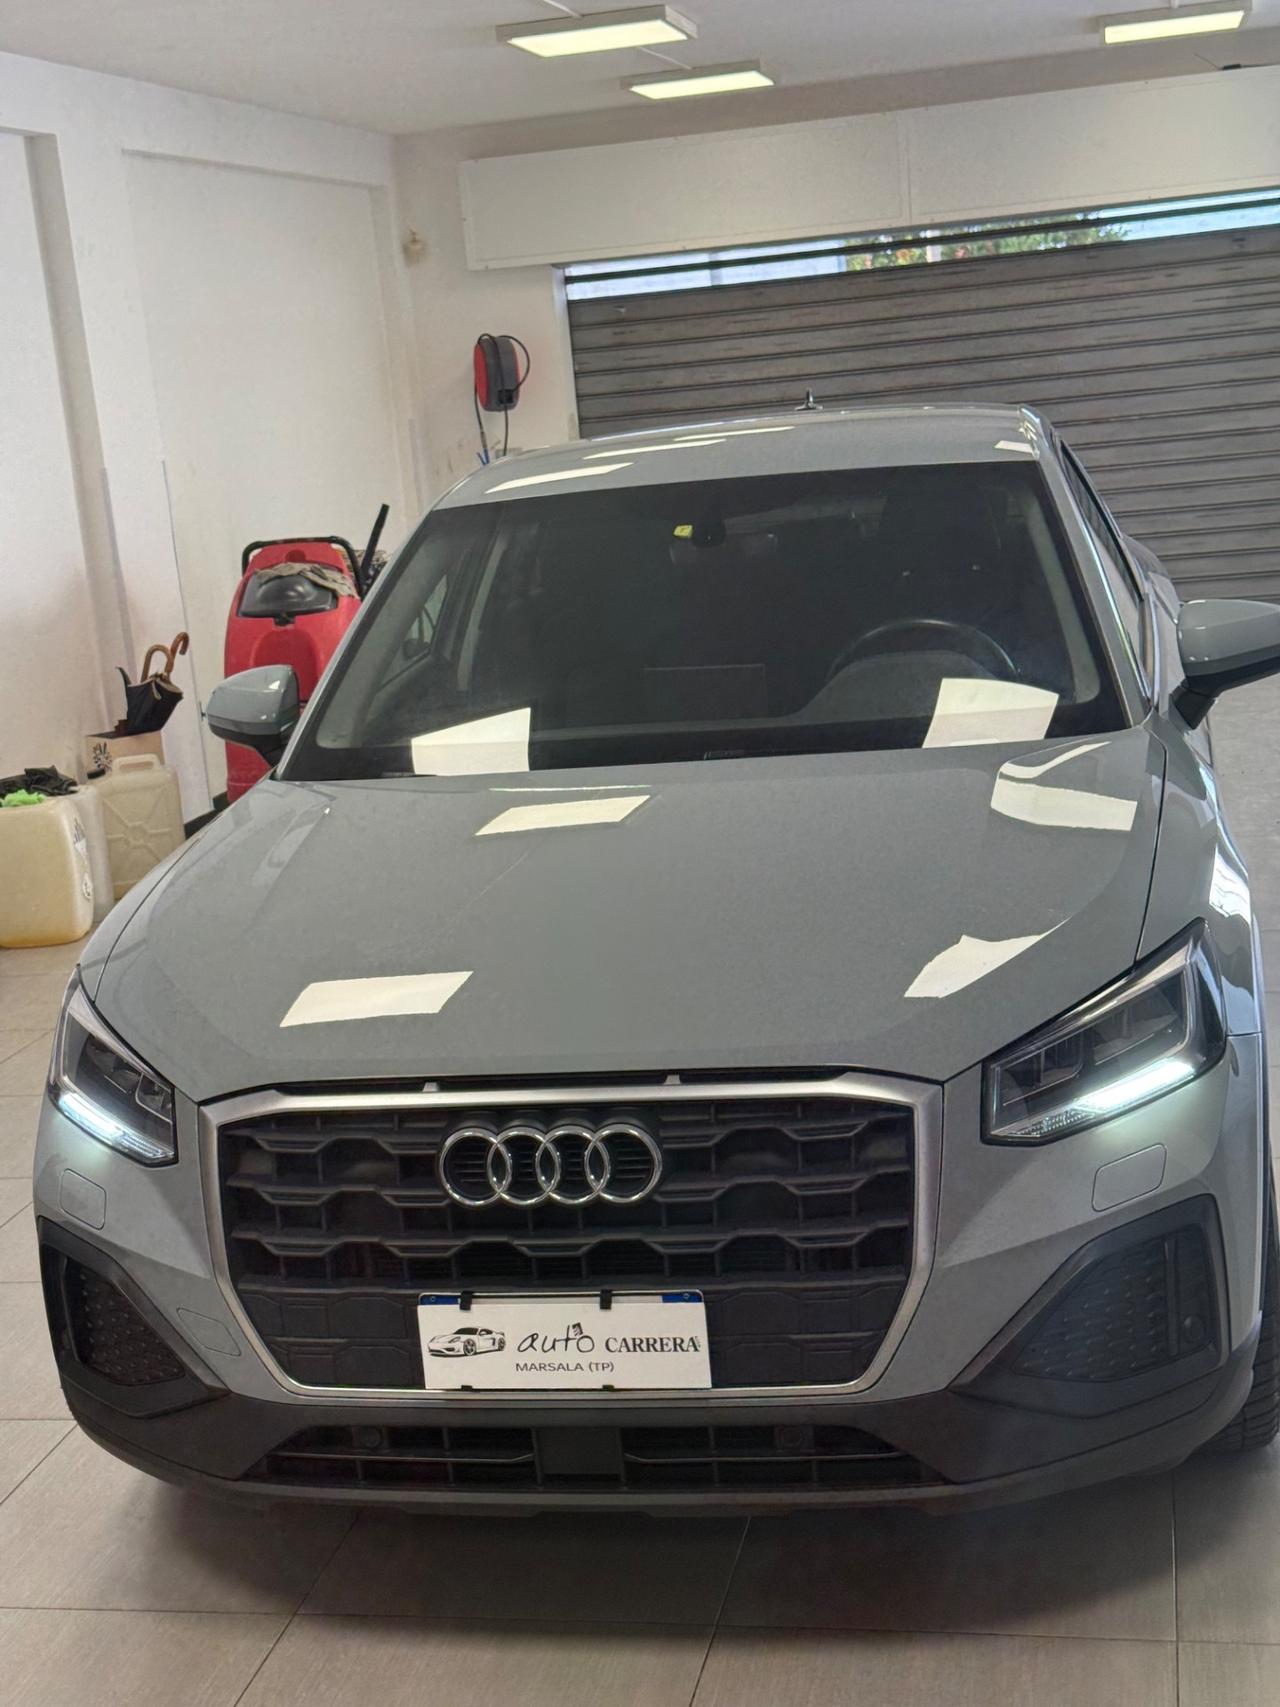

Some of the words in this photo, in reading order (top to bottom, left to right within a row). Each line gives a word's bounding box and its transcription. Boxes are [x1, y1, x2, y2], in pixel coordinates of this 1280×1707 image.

[517, 1324, 595, 1354] auto
[605, 1336, 700, 1353] CARRERA
[515, 1362, 584, 1373] MARSALA
[588, 1361, 615, 1373] (TP)
